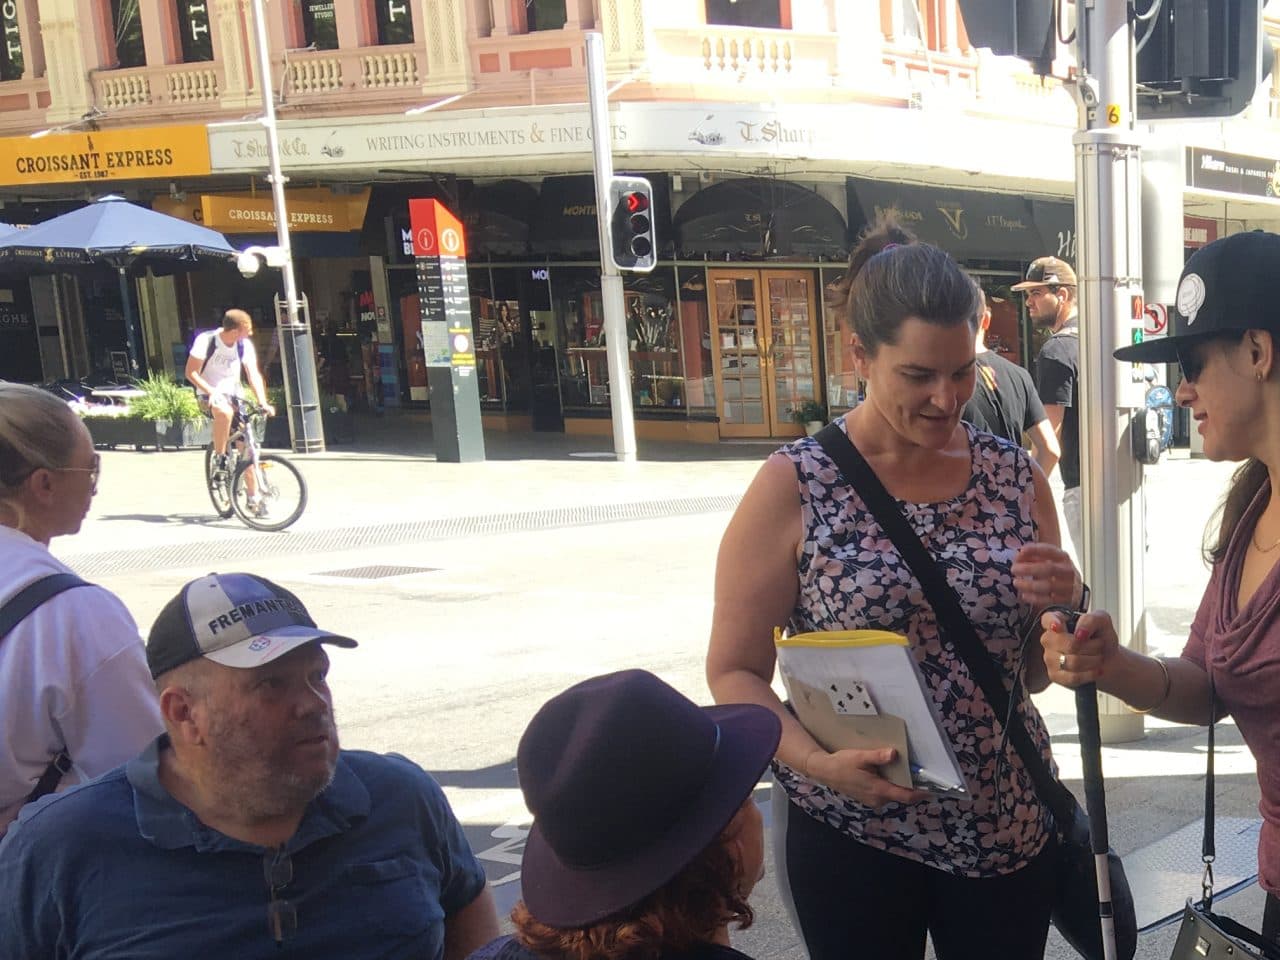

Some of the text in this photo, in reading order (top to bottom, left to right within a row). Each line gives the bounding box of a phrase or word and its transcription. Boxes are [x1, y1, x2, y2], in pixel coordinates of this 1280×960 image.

[1108, 106, 1119, 124] 6
[366, 134, 426, 152] WRITING
[427, 129, 525, 149] INSTRUMENTS
[529, 122, 545, 144] &
[550, 126, 583, 143] FINE
[16, 148, 173, 175] CROISSANT EXPRESS
[291, 212, 334, 224] EXPRESS
